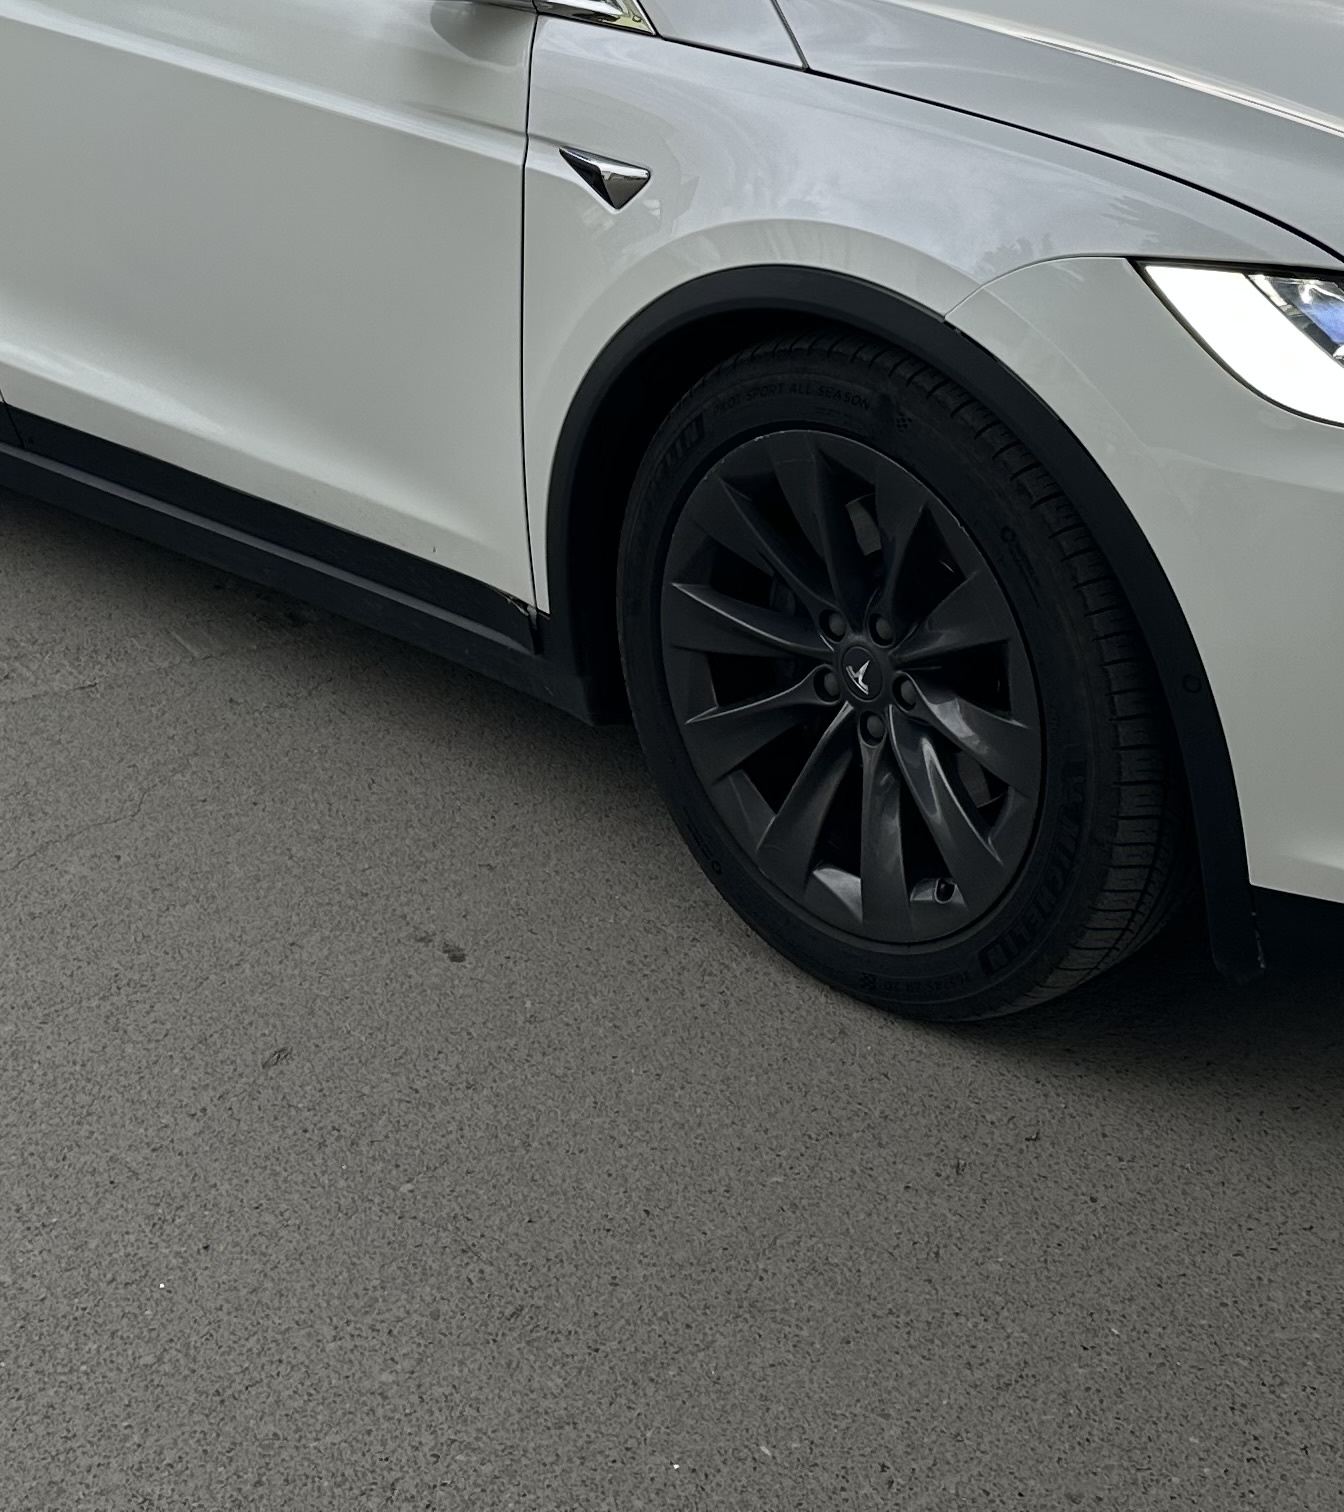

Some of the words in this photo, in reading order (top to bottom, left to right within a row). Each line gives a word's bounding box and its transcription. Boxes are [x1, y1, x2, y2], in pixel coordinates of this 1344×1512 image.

[745, 382, 786, 402] SPORT
[788, 382, 813, 396] ALL
[817, 385, 870, 411] SEASON
